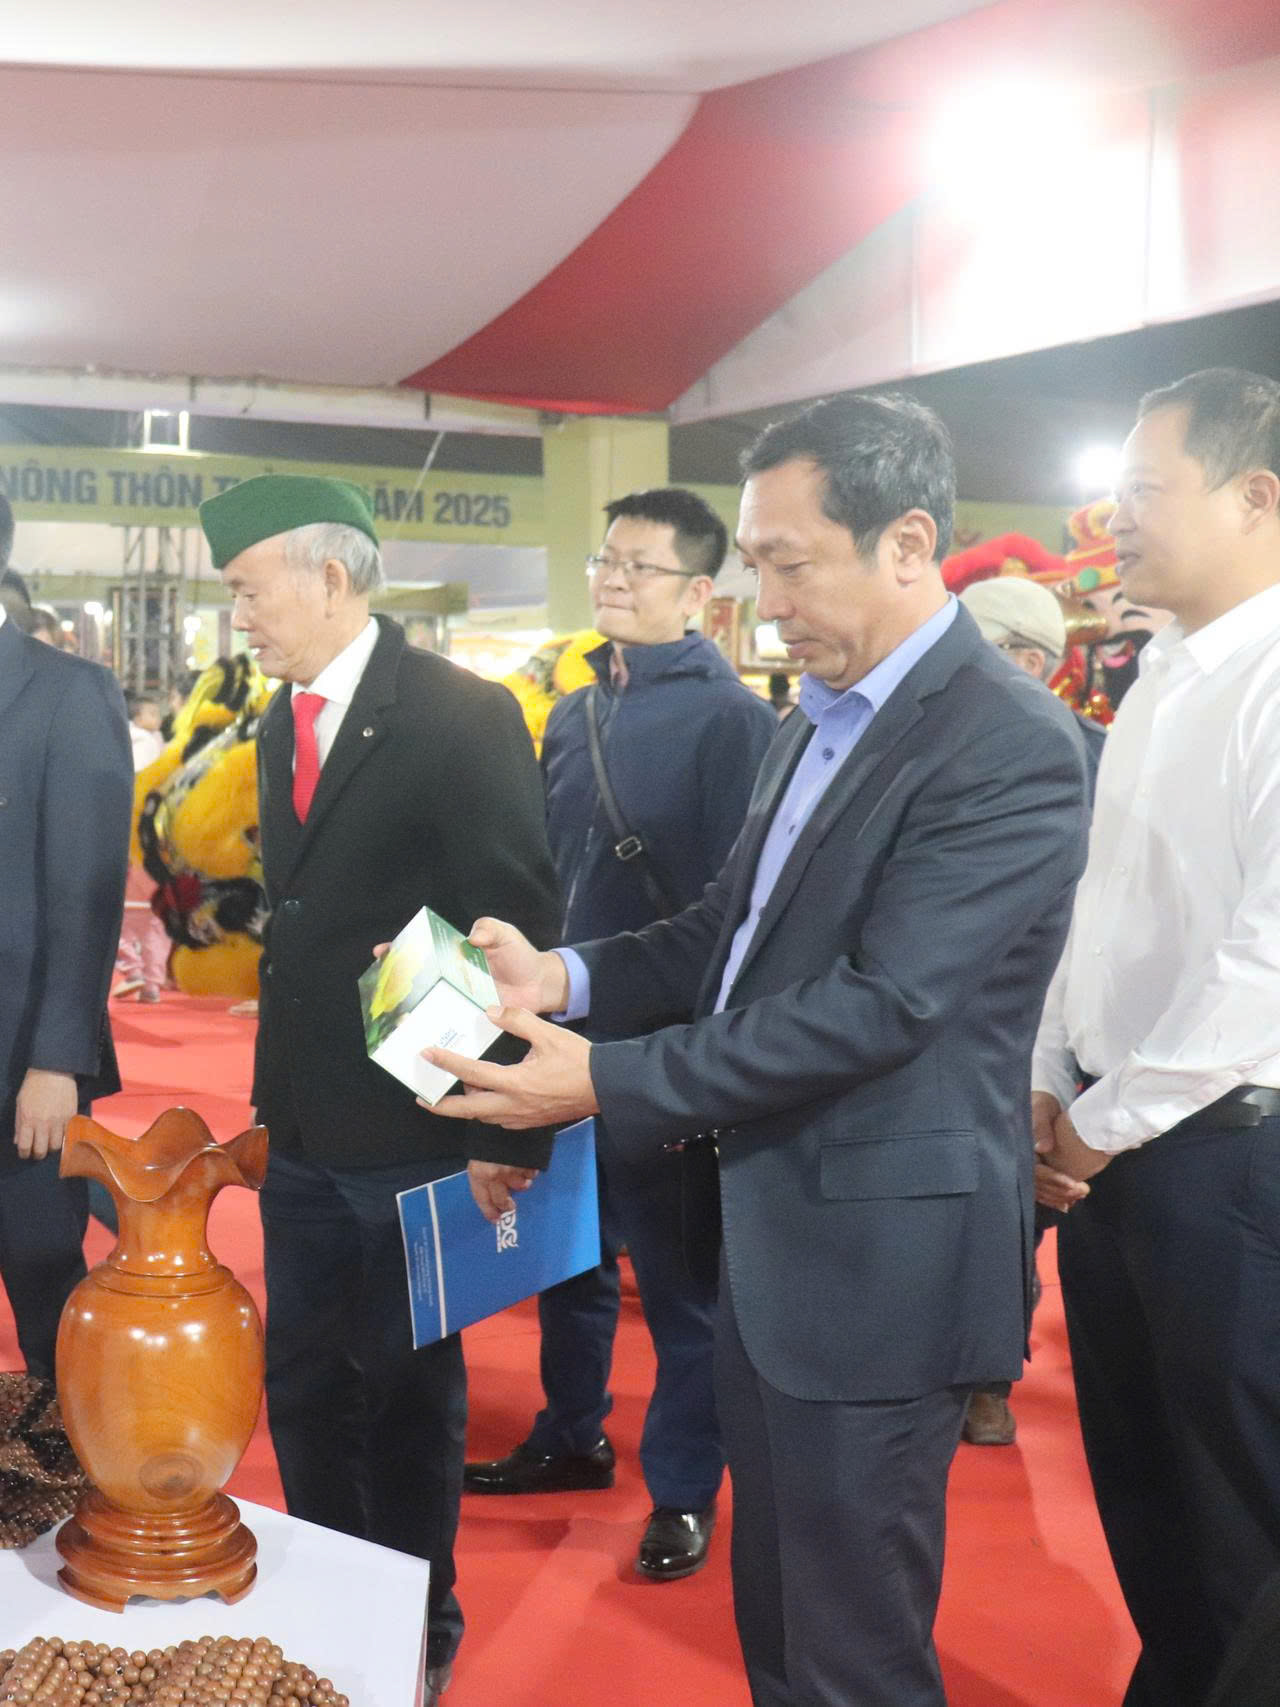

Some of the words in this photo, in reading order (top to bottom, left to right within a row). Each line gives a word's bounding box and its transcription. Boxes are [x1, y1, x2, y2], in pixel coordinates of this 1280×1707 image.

[106, 466, 203, 508] THÔN
[374, 479, 423, 522] ĂM
[432, 491, 511, 527] 2025
